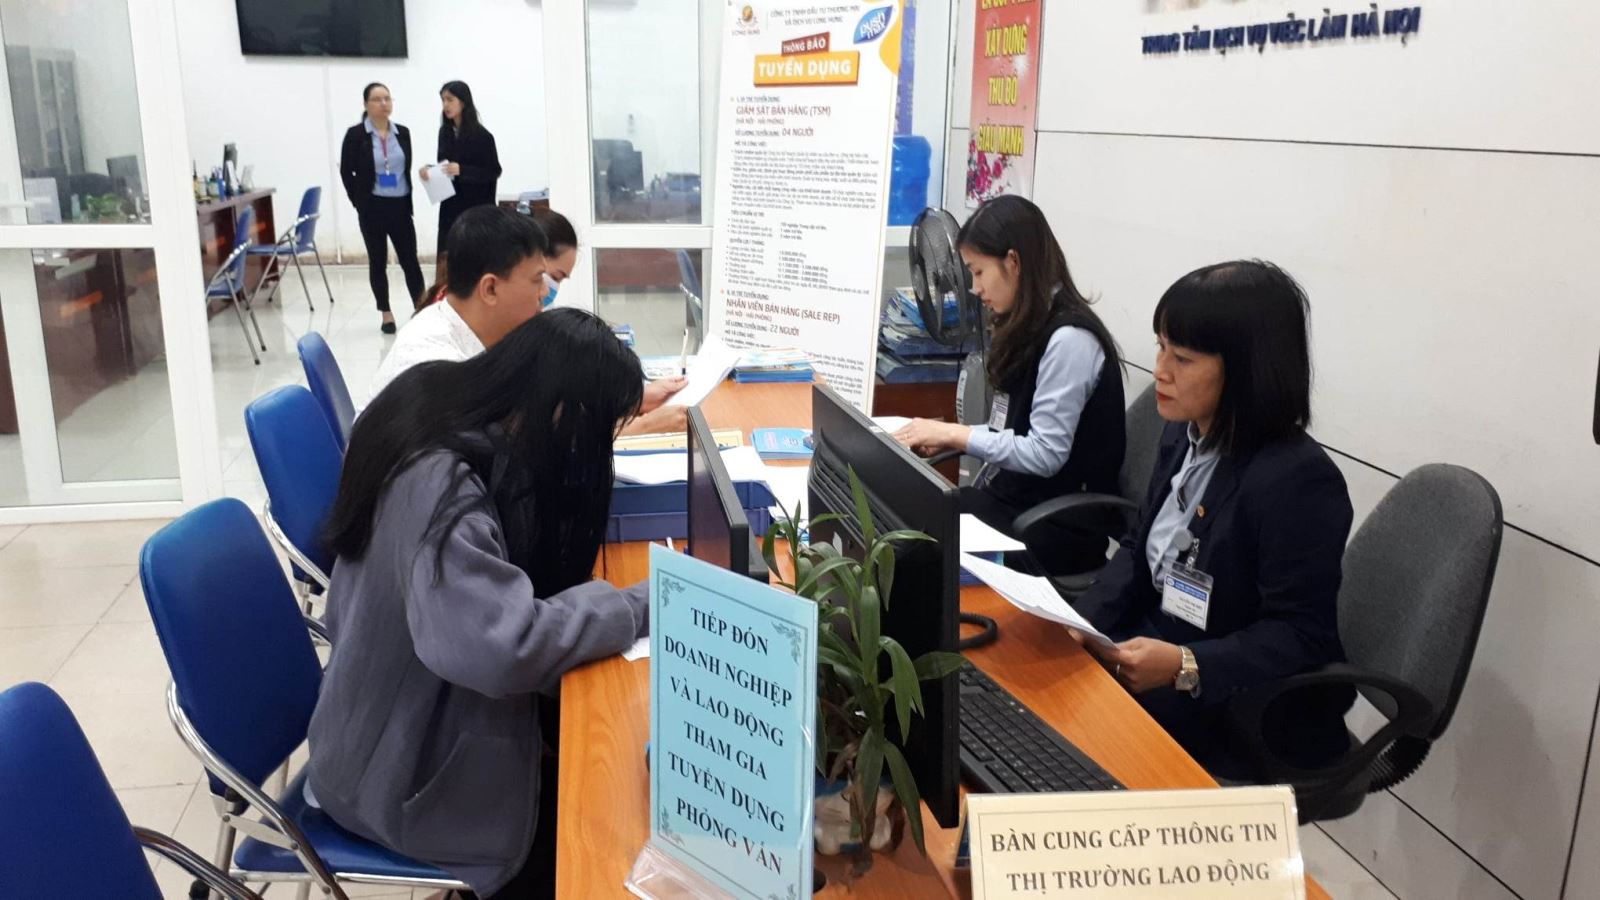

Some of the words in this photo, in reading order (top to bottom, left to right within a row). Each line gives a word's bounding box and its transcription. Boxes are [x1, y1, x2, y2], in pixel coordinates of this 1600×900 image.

[783, 41, 806, 53] THÔNG
[806, 37, 827, 50] BÁO
[985, 23, 1002, 57] XÂY
[1003, 22, 1028, 62] DỰNG
[1247, 24, 1268, 54] VỤ
[1351, 3, 1380, 38] HÀ
[758, 57, 804, 77] TUYỂN
[807, 59, 852, 79] DỤNG
[988, 66, 1004, 106] THỦ
[736, 104, 754, 115] GIÁM
[756, 104, 770, 115] SÁT
[771, 104, 786, 115] BÁN
[787, 104, 808, 116] HÀNG
[809, 106, 831, 117] (TSM)
[781, 127, 791, 136] 04
[792, 126, 814, 136] NGƯỜI
[977, 117, 996, 154] GIÀU
[997, 125, 1024, 157] MẠNH
[726, 297, 746, 309] NHÂN
[747, 299, 764, 311] VIÊN
[765, 301, 779, 314] BÁN
[780, 304, 800, 317] HÀNG
[801, 308, 822, 321] (SALE
[823, 312, 841, 324] REP)
[770, 323, 778, 333] 22
[779, 324, 800, 337] NGƯỜI
[691, 607, 727, 637] TIẾP
[732, 625, 768, 656] ĐÓN
[665, 635, 720, 676] DOANH
[725, 662, 792, 708] NGHIỆP
[671, 676, 691, 701] VÀ
[695, 688, 729, 719] LAO
[734, 707, 784, 747] ĐỘNG
[684, 720, 732, 761] THAM
[736, 750, 767, 780] GIA
[668, 751, 726, 800] TUYỂN
[731, 786, 784, 832] DỤNG
[677, 796, 737, 848] PHỎNG
[743, 840, 783, 875] VẤN
[990, 827, 1036, 852] BÀN
[1043, 829, 1103, 851] CUNG
[1109, 823, 1150, 847] CẤP
[1156, 821, 1234, 845] THÔNG
[1239, 822, 1278, 842] TIN
[1006, 871, 1047, 895] THỊ
[1052, 863, 1151, 890] TRƯỜNG
[1159, 865, 1201, 885] LAO
[1206, 859, 1270, 886] ĐỘNG
